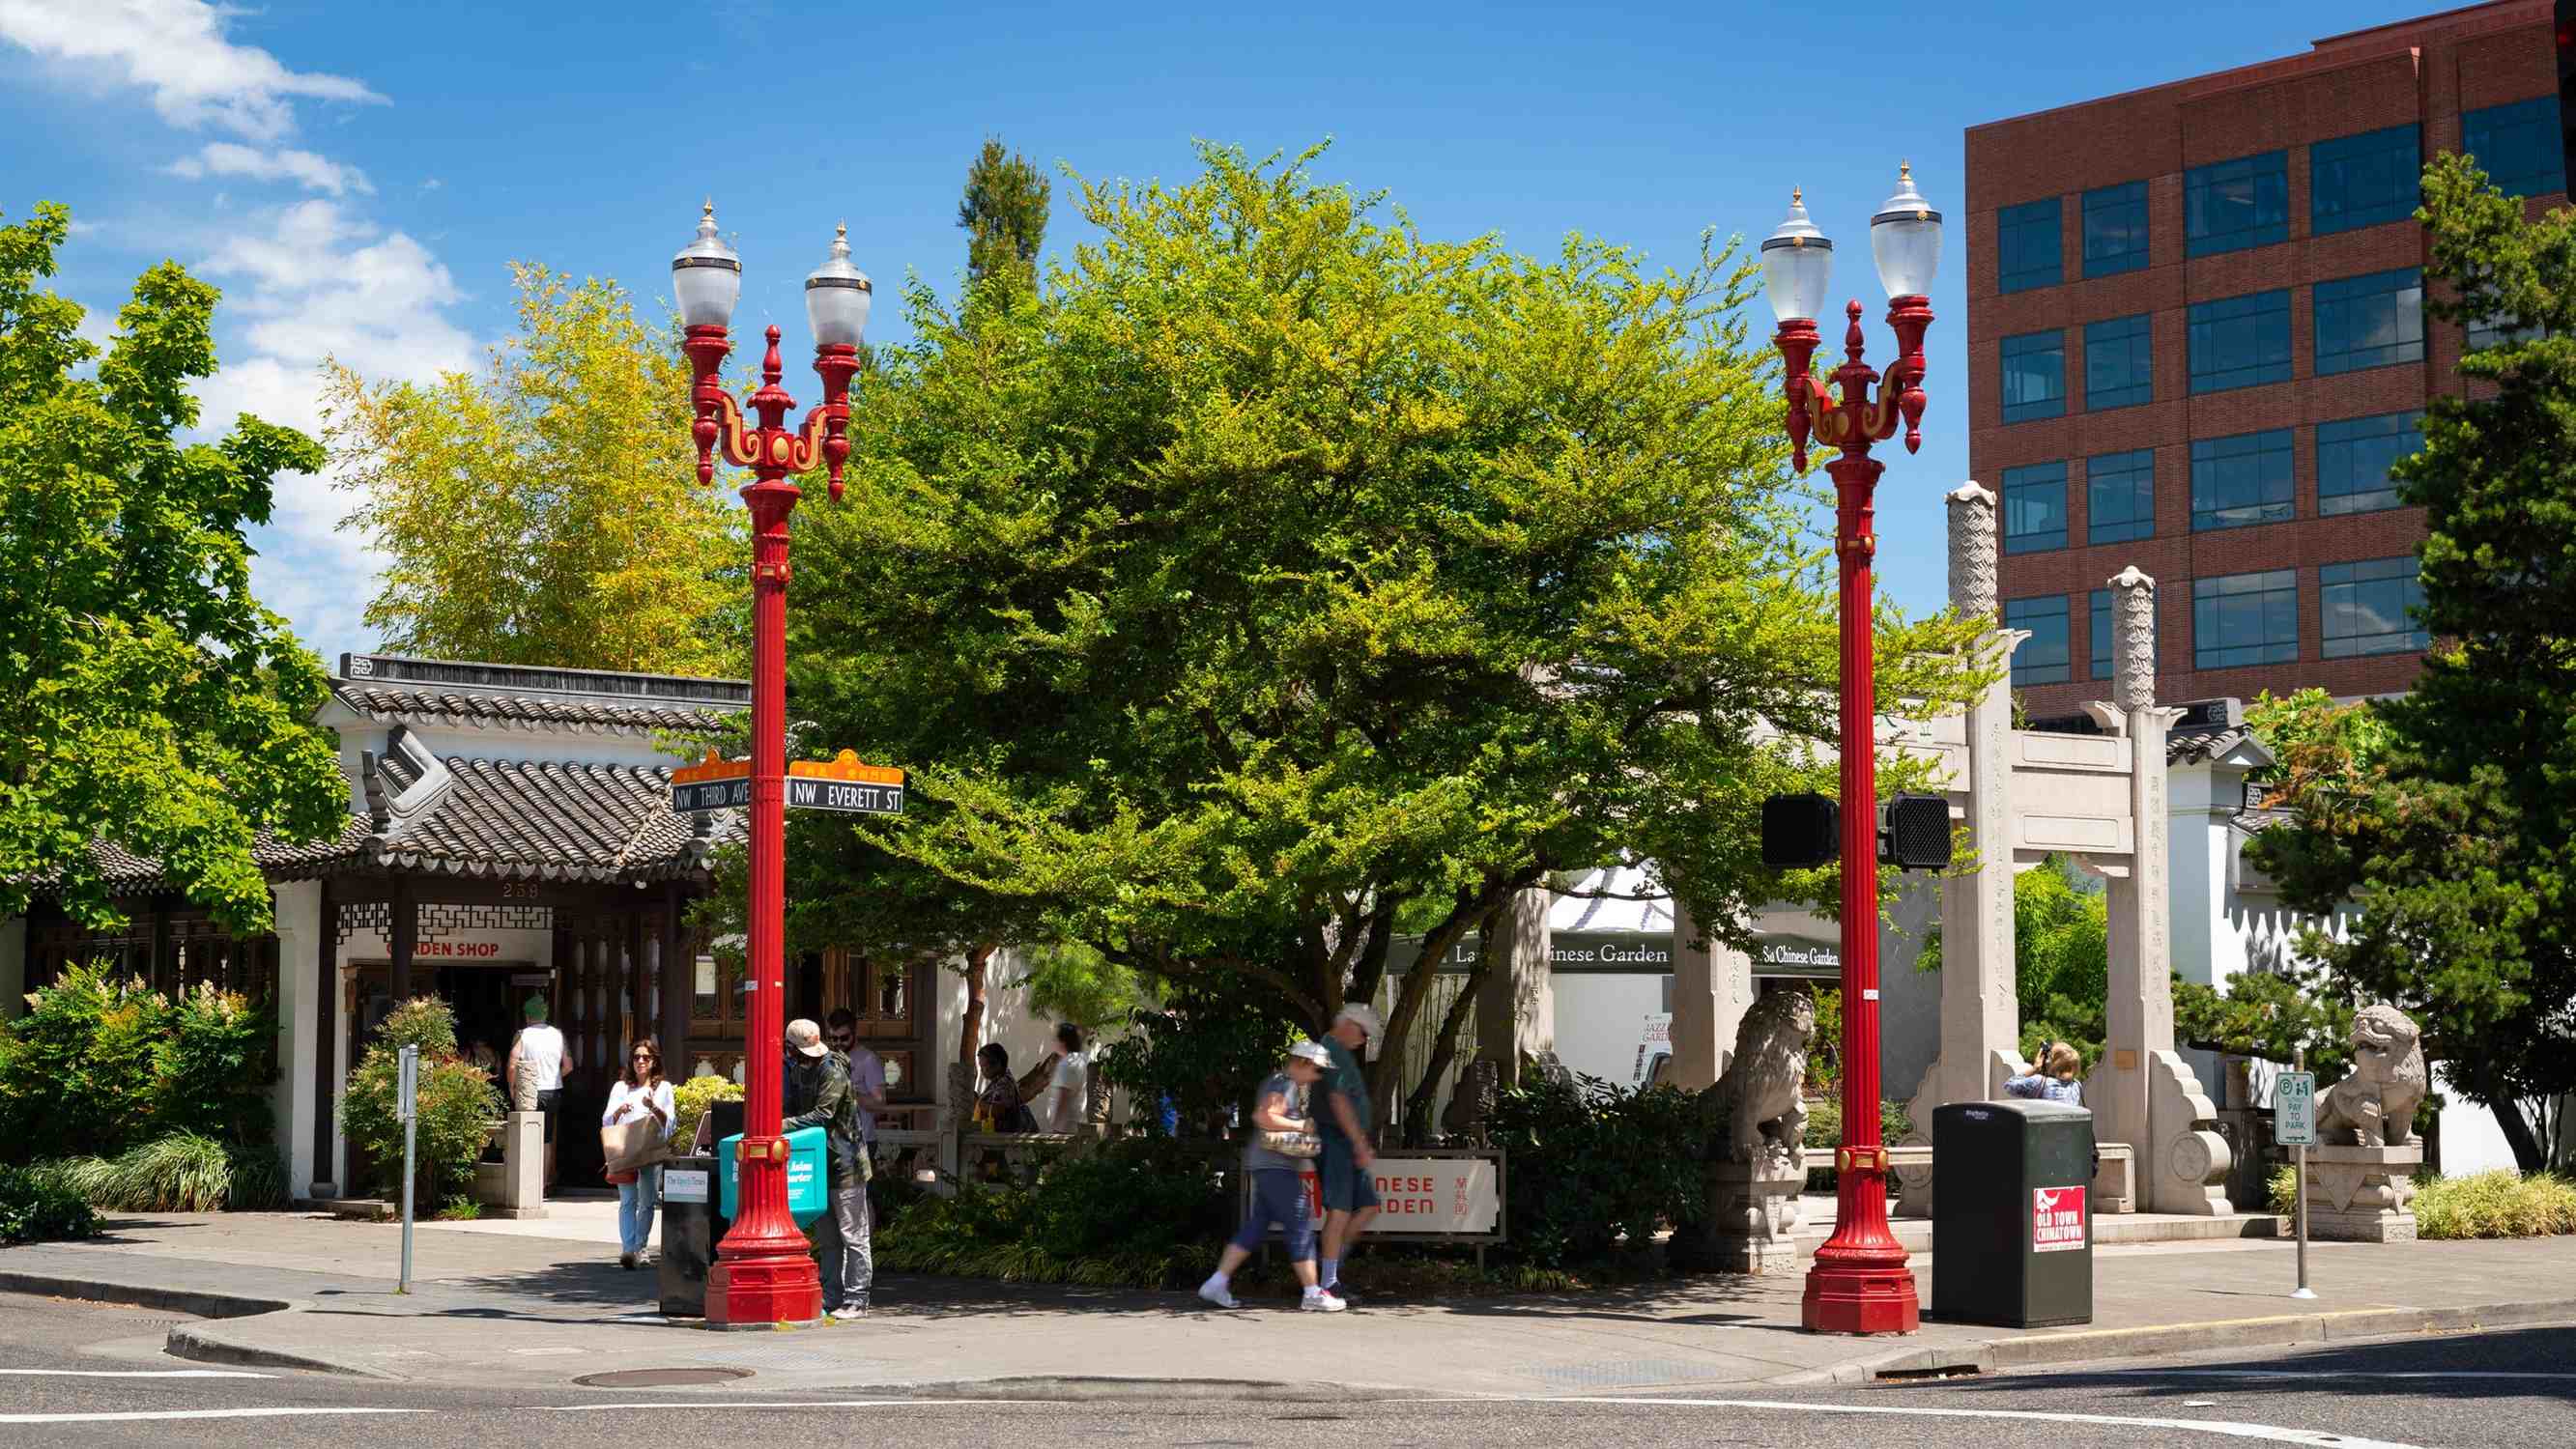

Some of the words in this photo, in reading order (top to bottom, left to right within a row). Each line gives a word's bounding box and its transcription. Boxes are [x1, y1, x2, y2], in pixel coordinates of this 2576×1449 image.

[676, 789, 692, 809] NW
[701, 785, 727, 807] THIRD
[731, 781, 751, 803] AVE
[795, 783, 816, 803] NW
[828, 784, 879, 808] EVERETT
[886, 790, 901, 810] ST
[456, 942, 499, 957] SHOP
[1455, 945, 1475, 962] La
[1550, 944, 1594, 962] inese
[1600, 944, 1669, 963] Garden
[1776, 945, 1809, 963] Chinese
[1809, 947, 1839, 966] Garden
[2288, 1103, 2304, 1112] PAY
[2290, 1112, 2301, 1122] TO
[2285, 1121, 2305, 1129] PARK
[1375, 1177, 1435, 1192] NESE
[1376, 1199, 1434, 1214] DEN
[2037, 1212, 2053, 1227] OLD
[2054, 1211, 2078, 1225] TOWN
[2037, 1225, 2082, 1241] CHINATOWN
